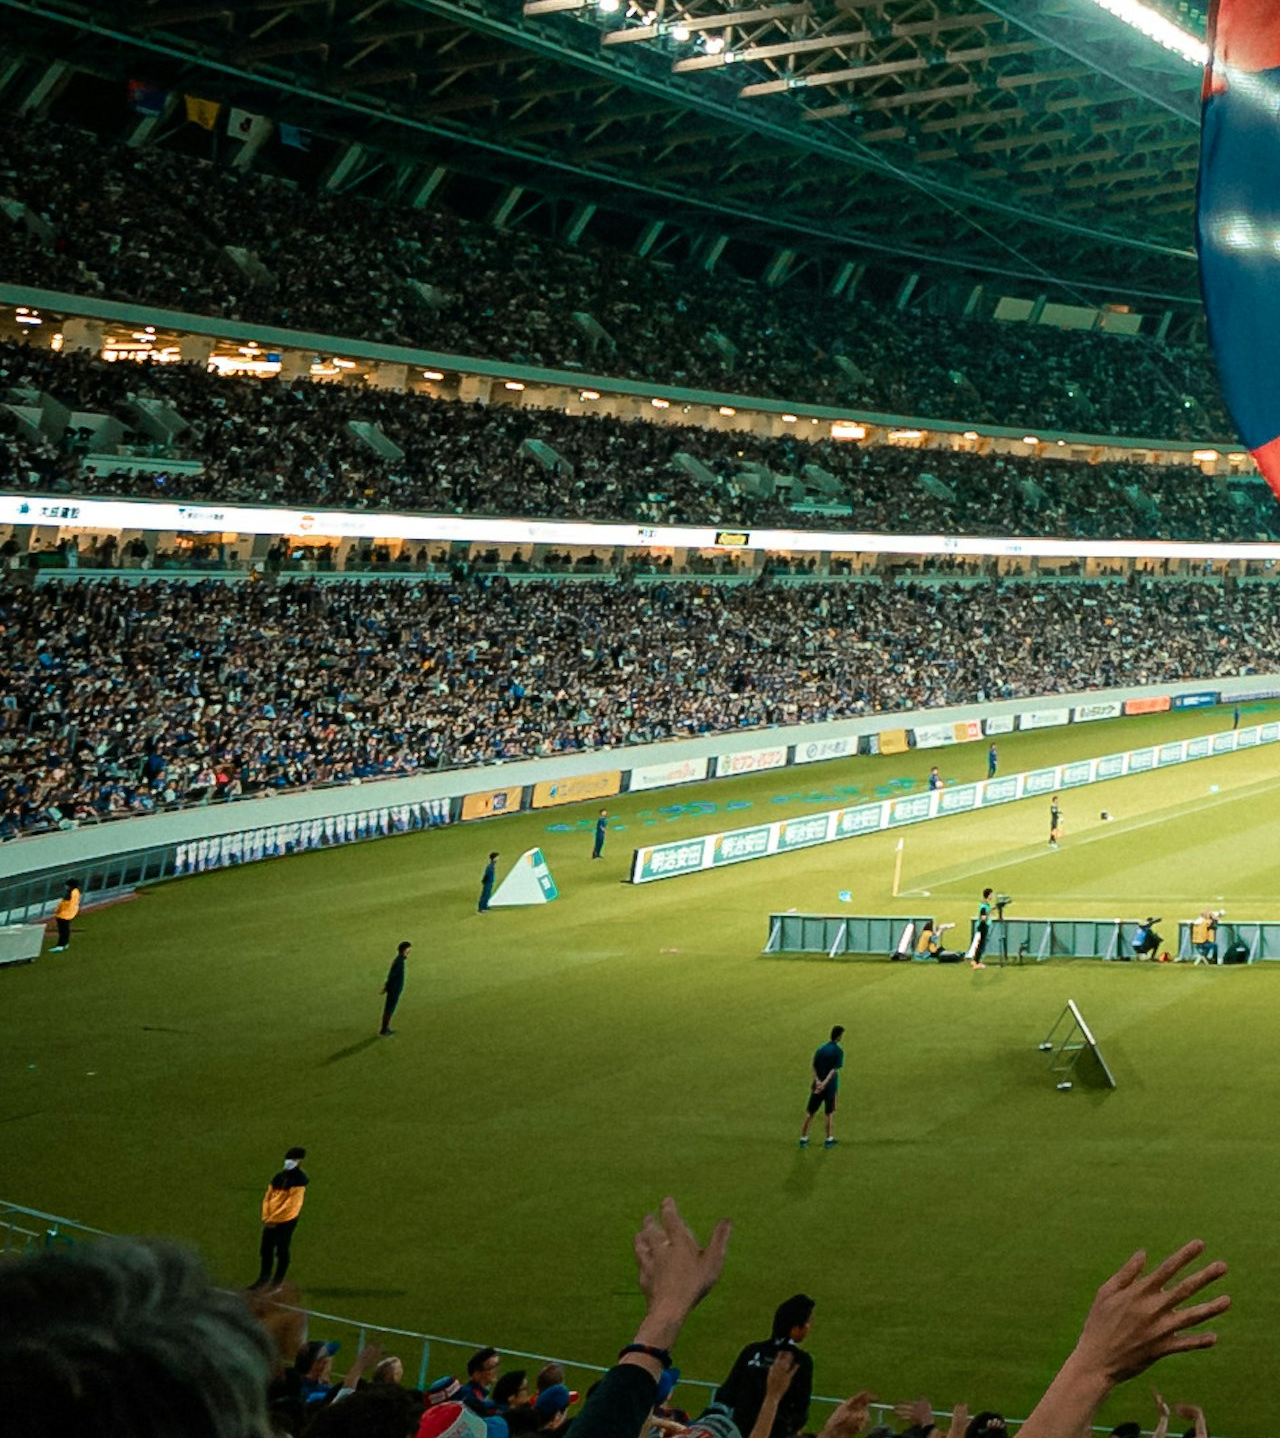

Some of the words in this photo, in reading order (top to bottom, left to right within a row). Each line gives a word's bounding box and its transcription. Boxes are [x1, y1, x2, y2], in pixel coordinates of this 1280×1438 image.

[652, 843, 702, 873] 明治安田
[721, 829, 770, 859] 明治安田
